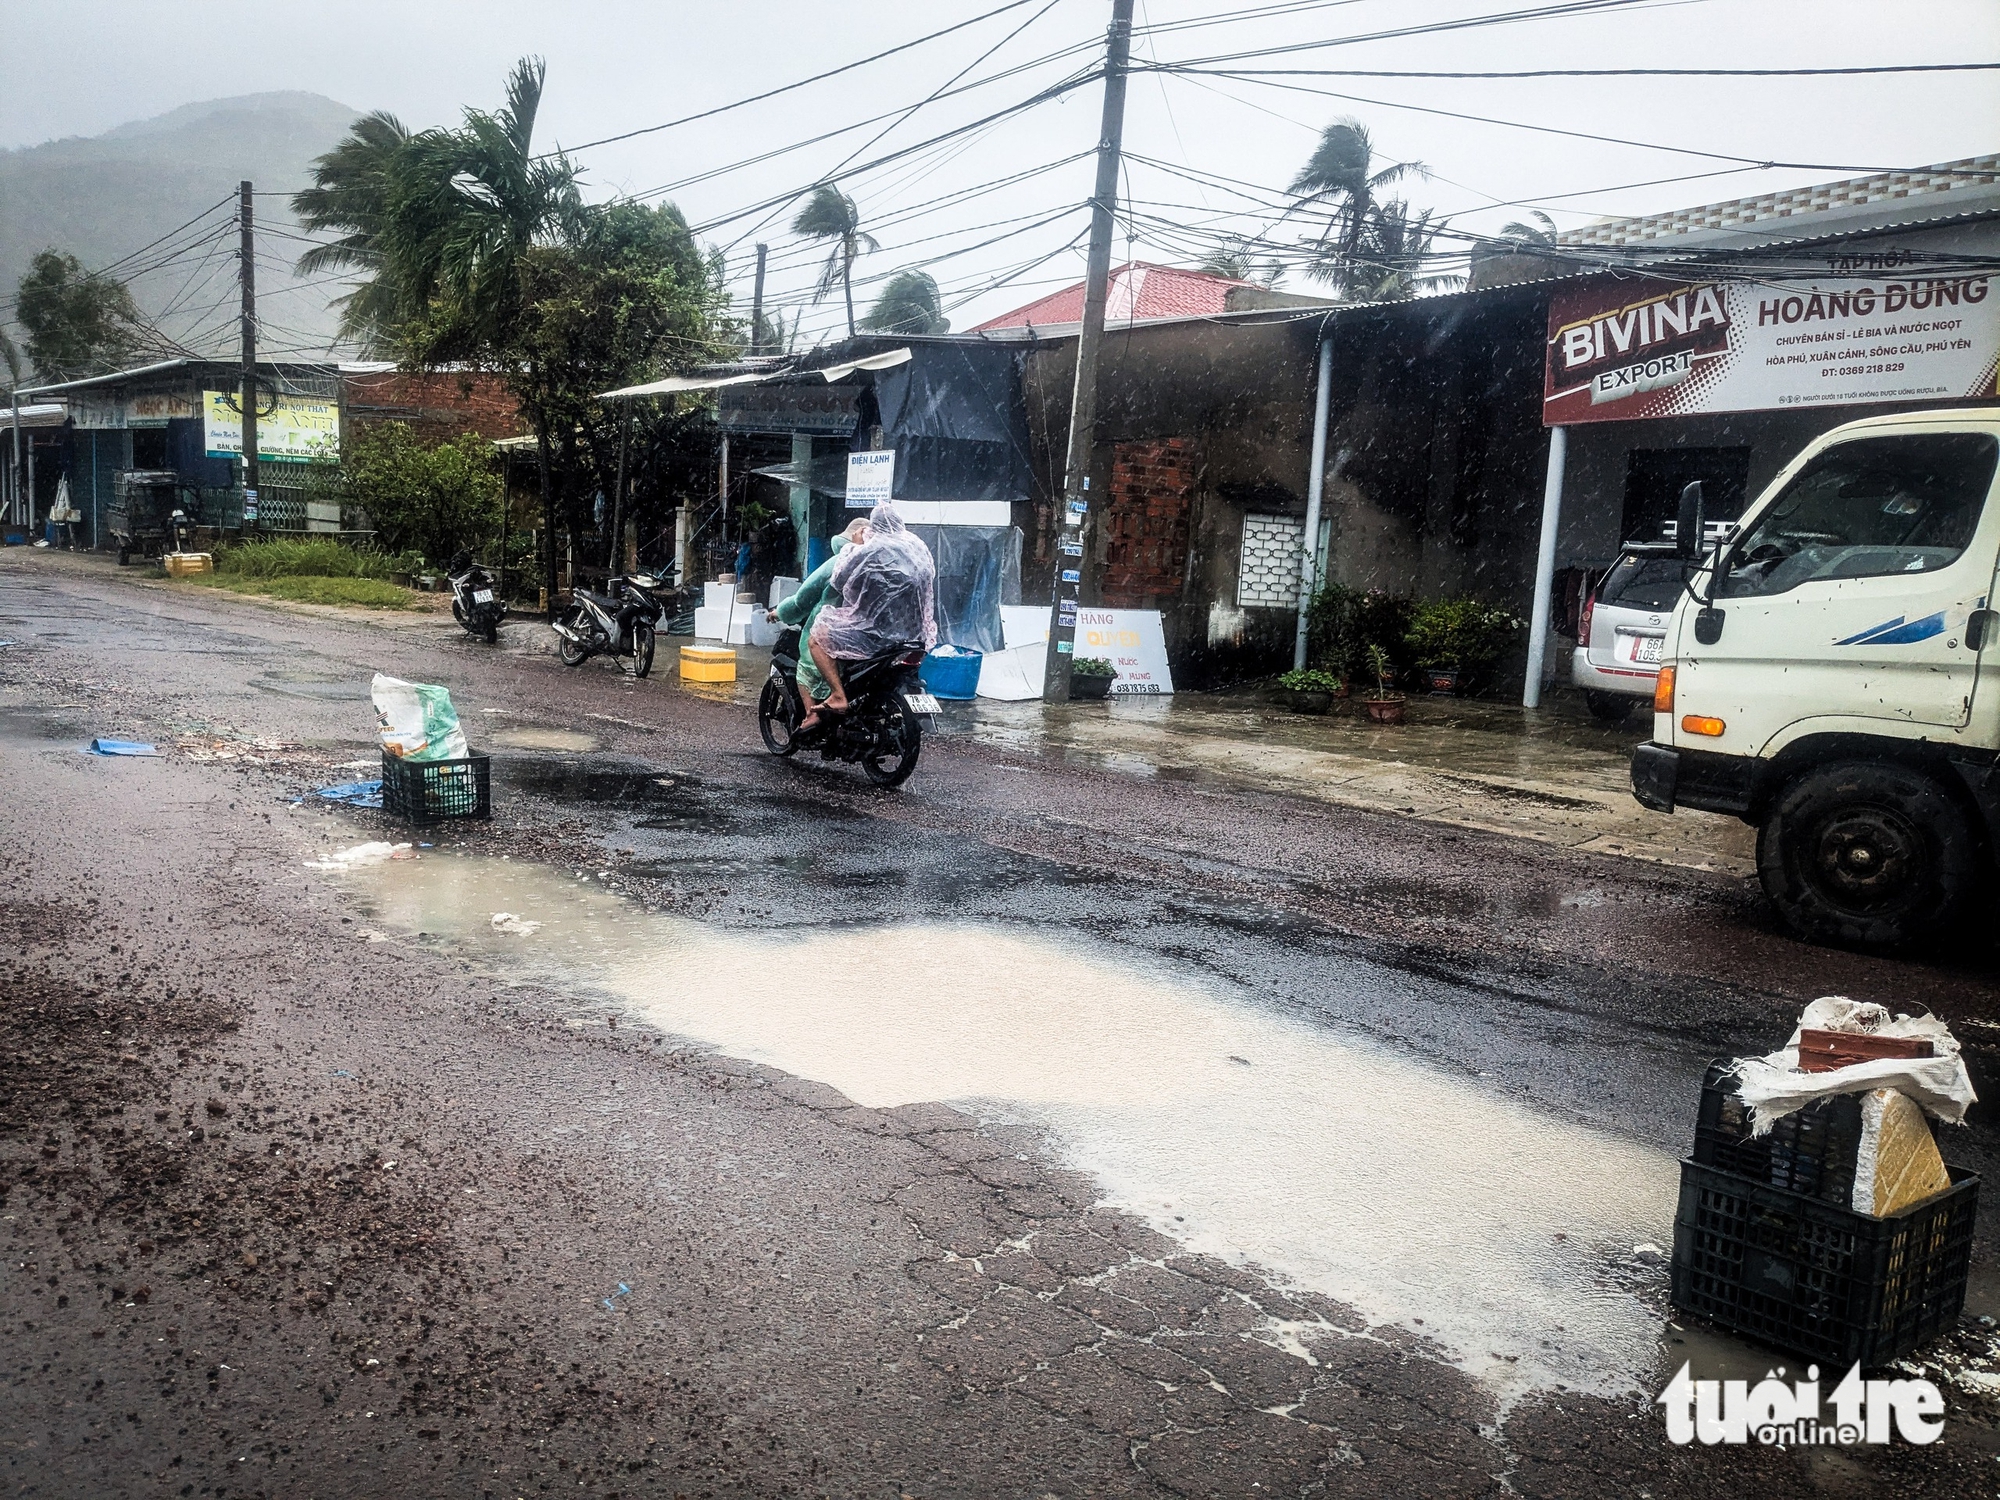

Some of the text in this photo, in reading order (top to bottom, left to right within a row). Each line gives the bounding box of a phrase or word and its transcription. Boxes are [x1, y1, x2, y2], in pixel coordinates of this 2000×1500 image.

[1758, 286, 1876, 326] HOÀNG
[1563, 286, 1726, 368] BIVINA
[1776, 334, 1813, 346] CHUYÊN
[1815, 331, 1835, 342] BÁN
[1865, 327, 1882, 338] BIA
[1884, 323, 1897, 336] VÀ
[1899, 321, 1931, 334] NƯỚC
[1932, 319, 1962, 332] NGỌT
[1766, 338, 1971, 366] HÒA PHÚ, XUÂN CẢNH, SÔNG CẦU, PHÚ YÊN
[1599, 351, 1694, 391] EXPORT
[1821, 362, 1905, 377] ĐT: 0369 218 829
[852, 454, 890, 466] ĐIỆN LẠNH
